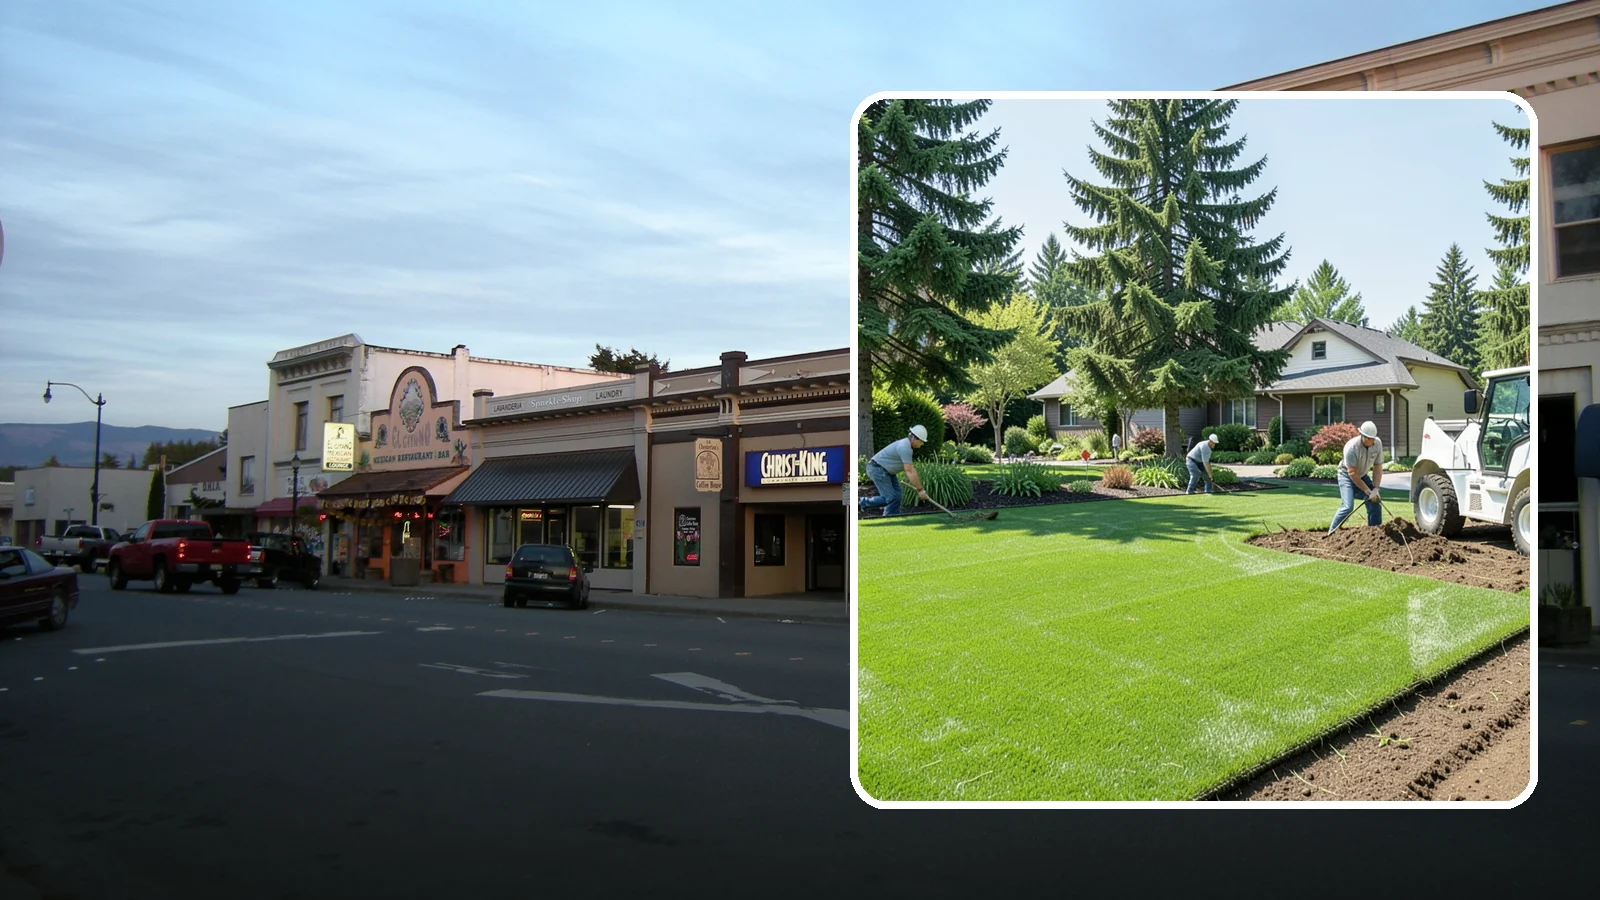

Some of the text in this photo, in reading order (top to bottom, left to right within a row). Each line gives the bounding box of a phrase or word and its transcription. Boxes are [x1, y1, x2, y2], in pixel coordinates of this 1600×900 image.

[493, 389, 623, 412] LAVANDERIA Sparkle Shop LAUNDRY
[374, 450, 450, 463] MEXICAN RESTAURANT BAR
[799, 450, 827, 476] KING
